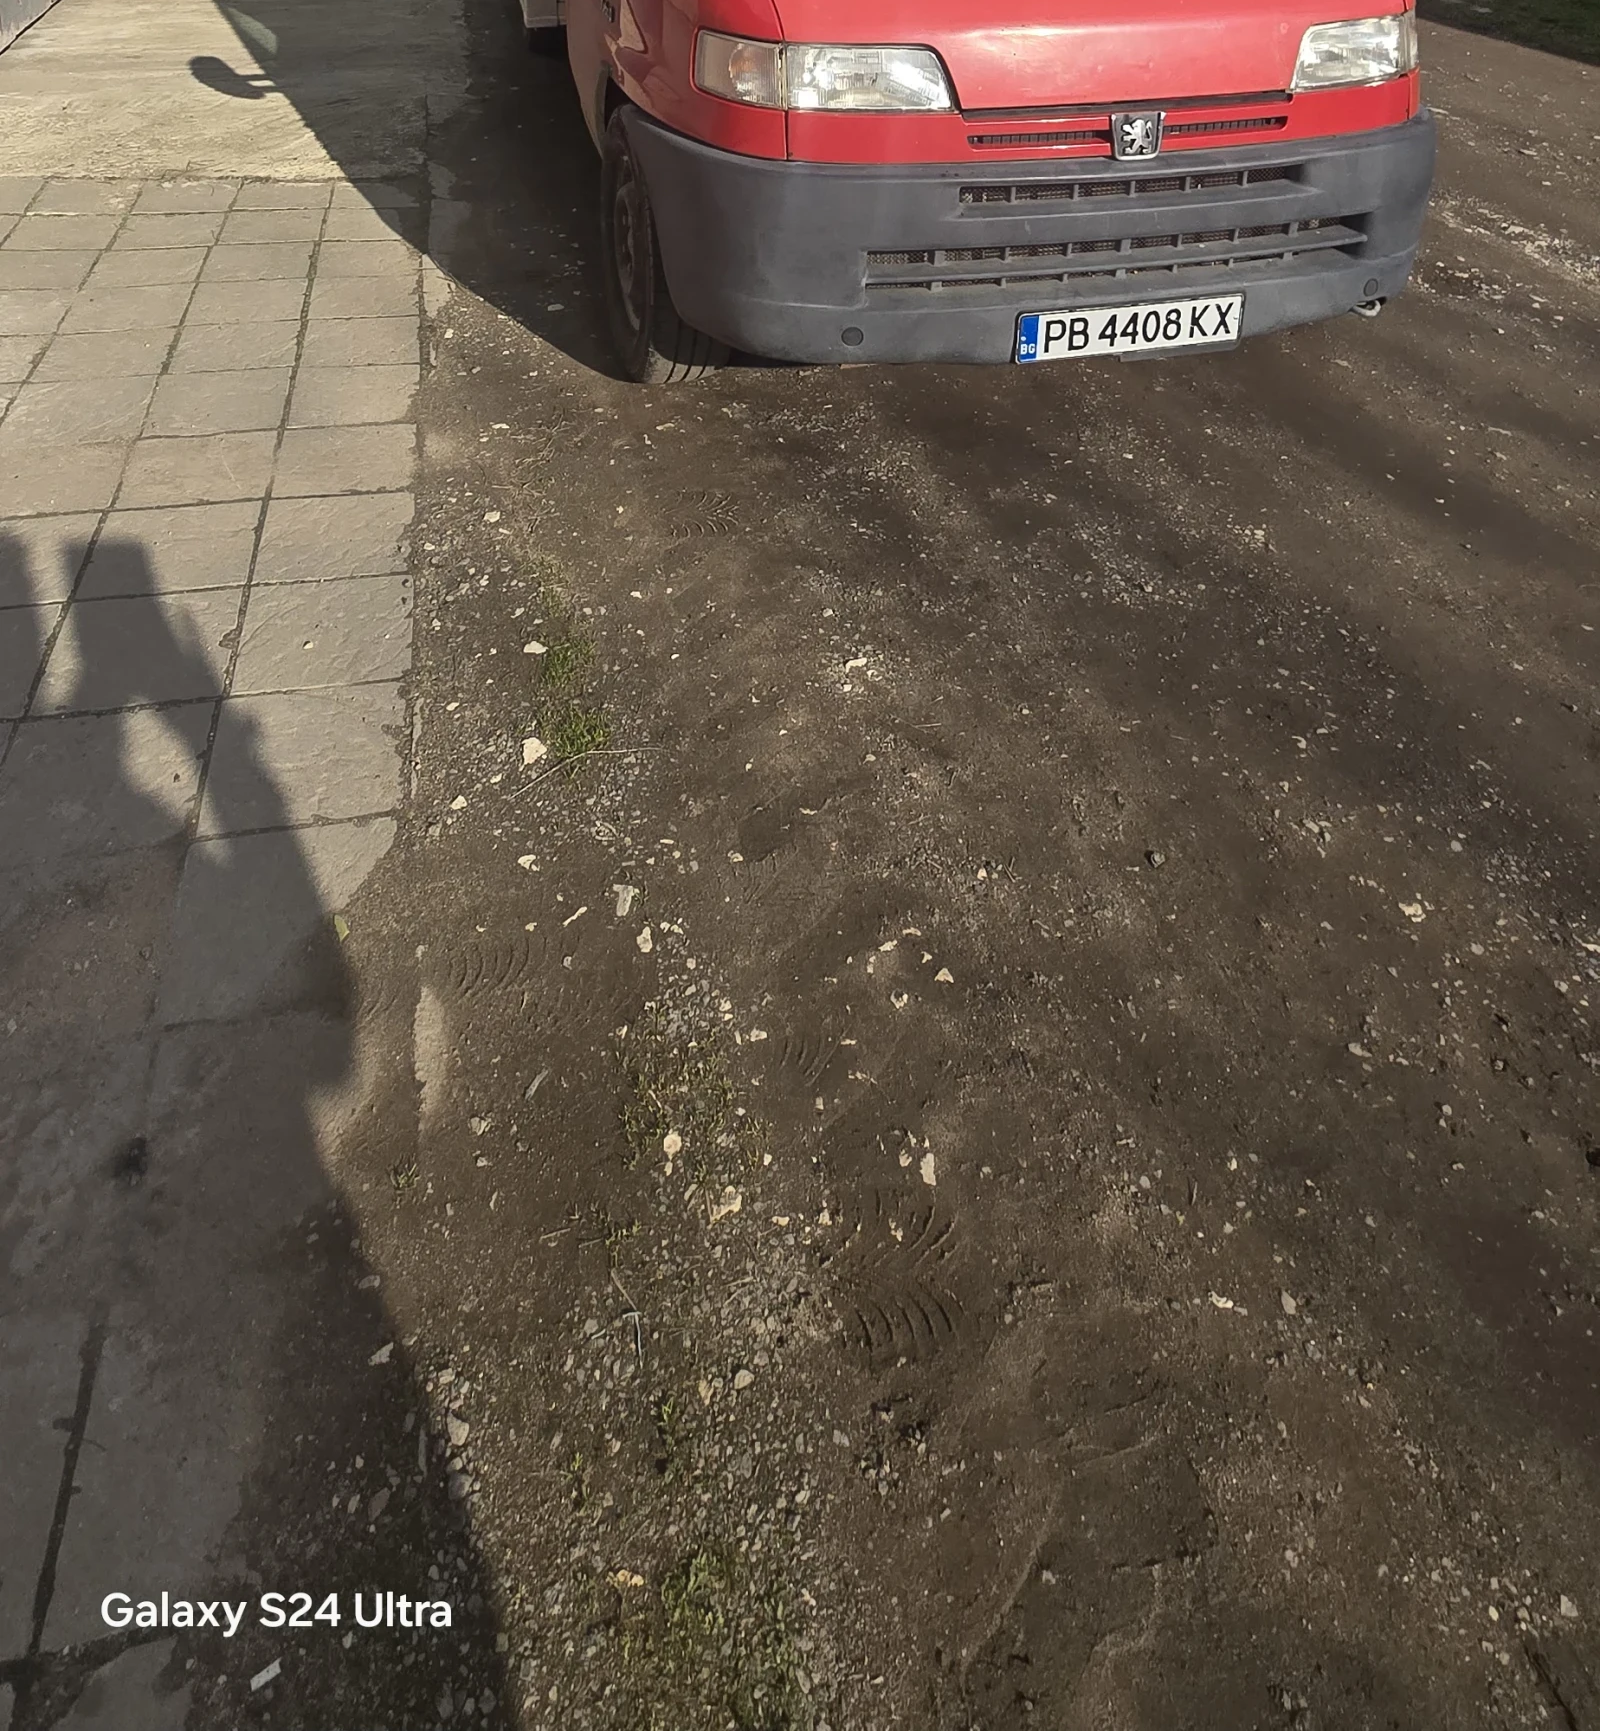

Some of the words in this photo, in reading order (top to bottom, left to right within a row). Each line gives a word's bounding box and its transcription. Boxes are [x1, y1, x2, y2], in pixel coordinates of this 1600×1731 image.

[1043, 317, 1090, 354] PB
[1098, 308, 1182, 347] 4408
[1188, 302, 1235, 339] KX
[1020, 343, 1036, 355] BG
